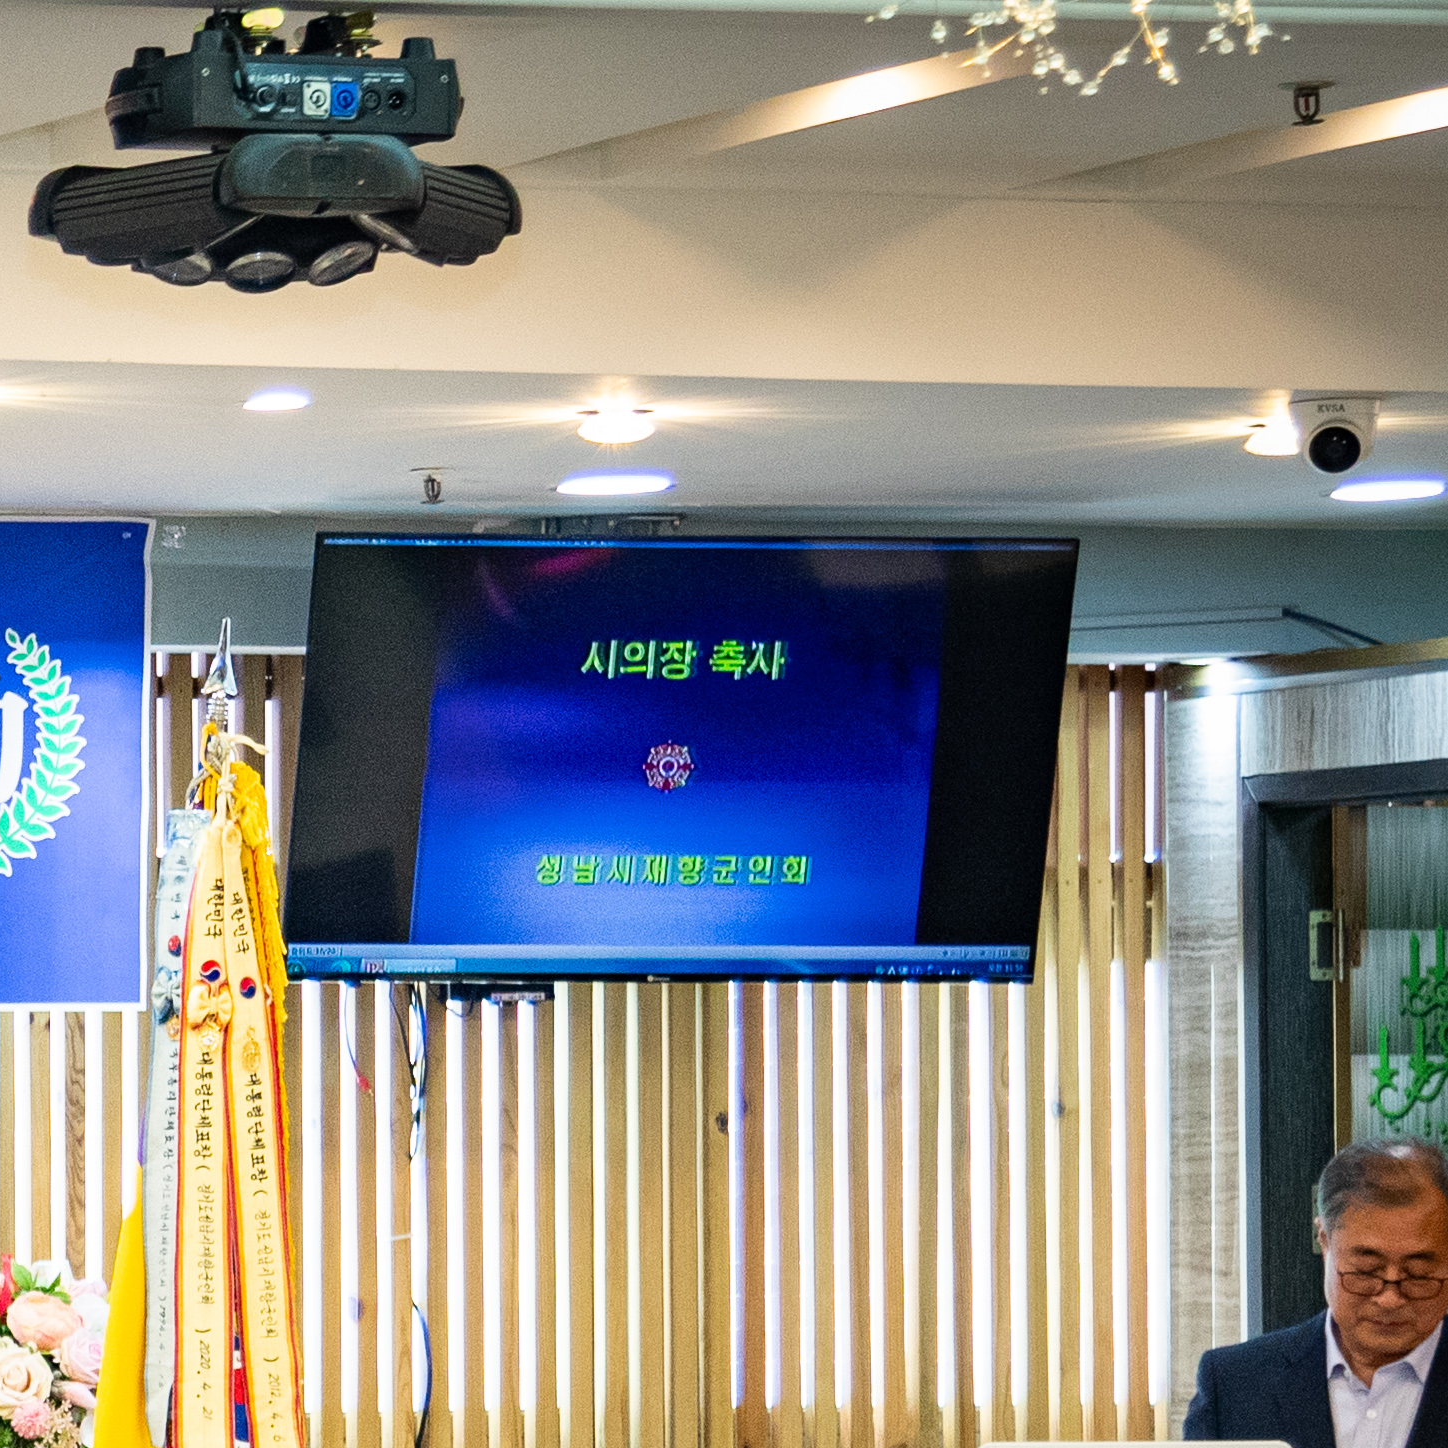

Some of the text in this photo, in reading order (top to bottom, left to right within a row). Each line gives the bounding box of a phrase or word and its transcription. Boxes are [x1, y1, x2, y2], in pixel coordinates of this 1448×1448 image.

[580, 638, 785, 682] 시의장 축사
[230, 891, 250, 954] 대한민국
